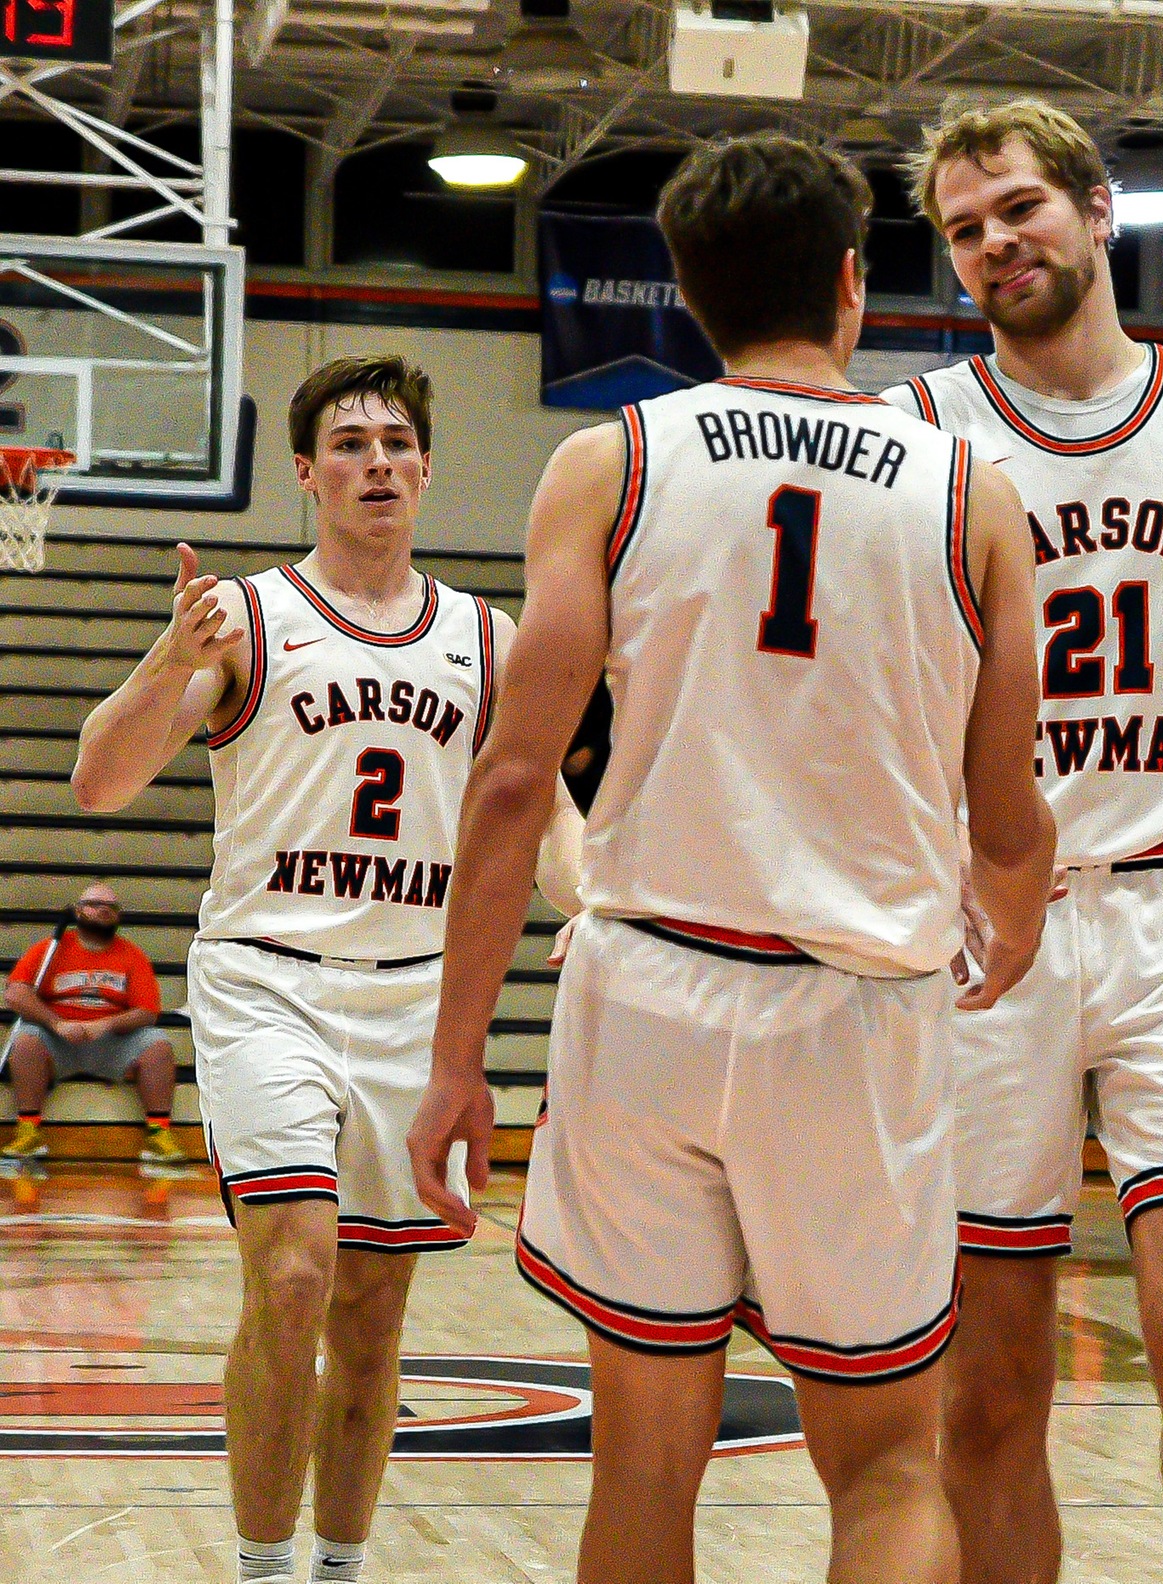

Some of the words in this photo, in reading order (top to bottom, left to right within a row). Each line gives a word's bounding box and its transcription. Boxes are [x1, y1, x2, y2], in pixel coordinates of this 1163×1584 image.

[696, 409, 907, 489] BROWDER
[757, 483, 822, 659] 1
[446, 653, 473, 668] SAC
[1042, 580, 1154, 700] 21
[290, 678, 465, 748] CARSON
[349, 746, 405, 841] 2
[266, 850, 452, 909] NEWMAN
